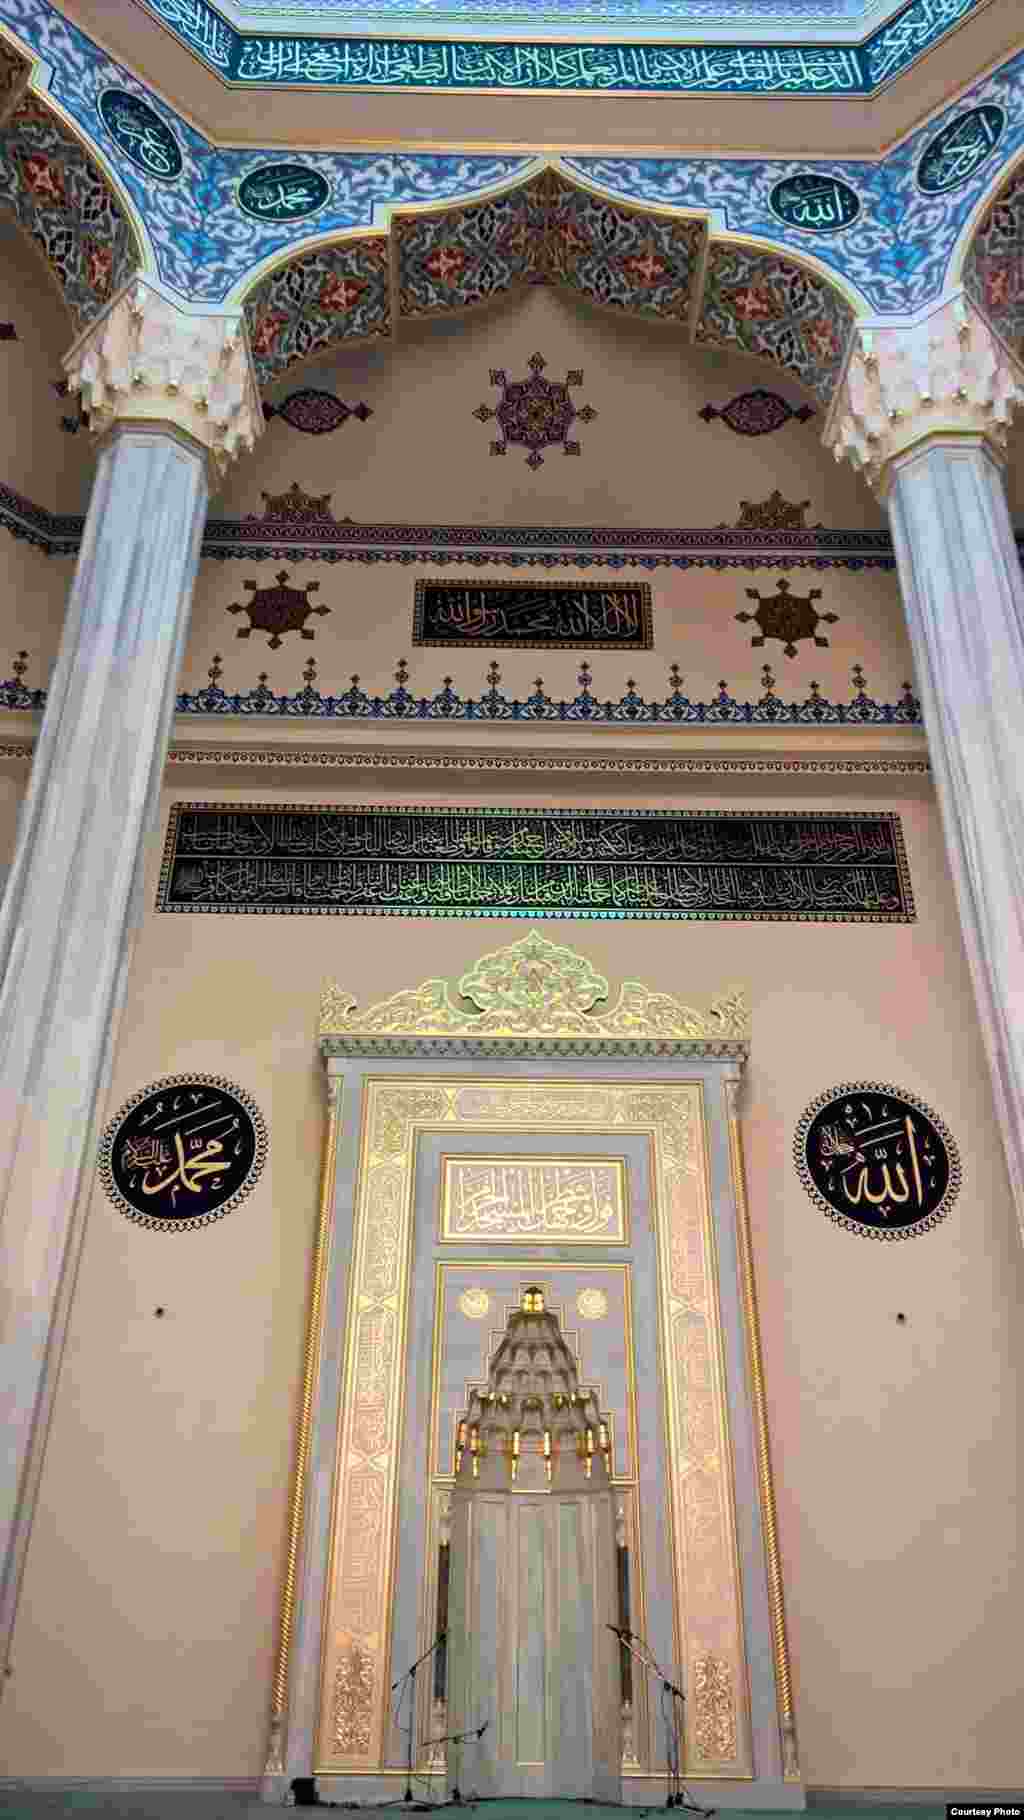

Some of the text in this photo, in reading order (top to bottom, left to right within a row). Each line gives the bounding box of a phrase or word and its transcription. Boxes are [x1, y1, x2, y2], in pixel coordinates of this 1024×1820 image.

[792, 183, 845, 222] الله
[142, 1131, 231, 1194] محمد
[840, 1114, 923, 1208] الله
